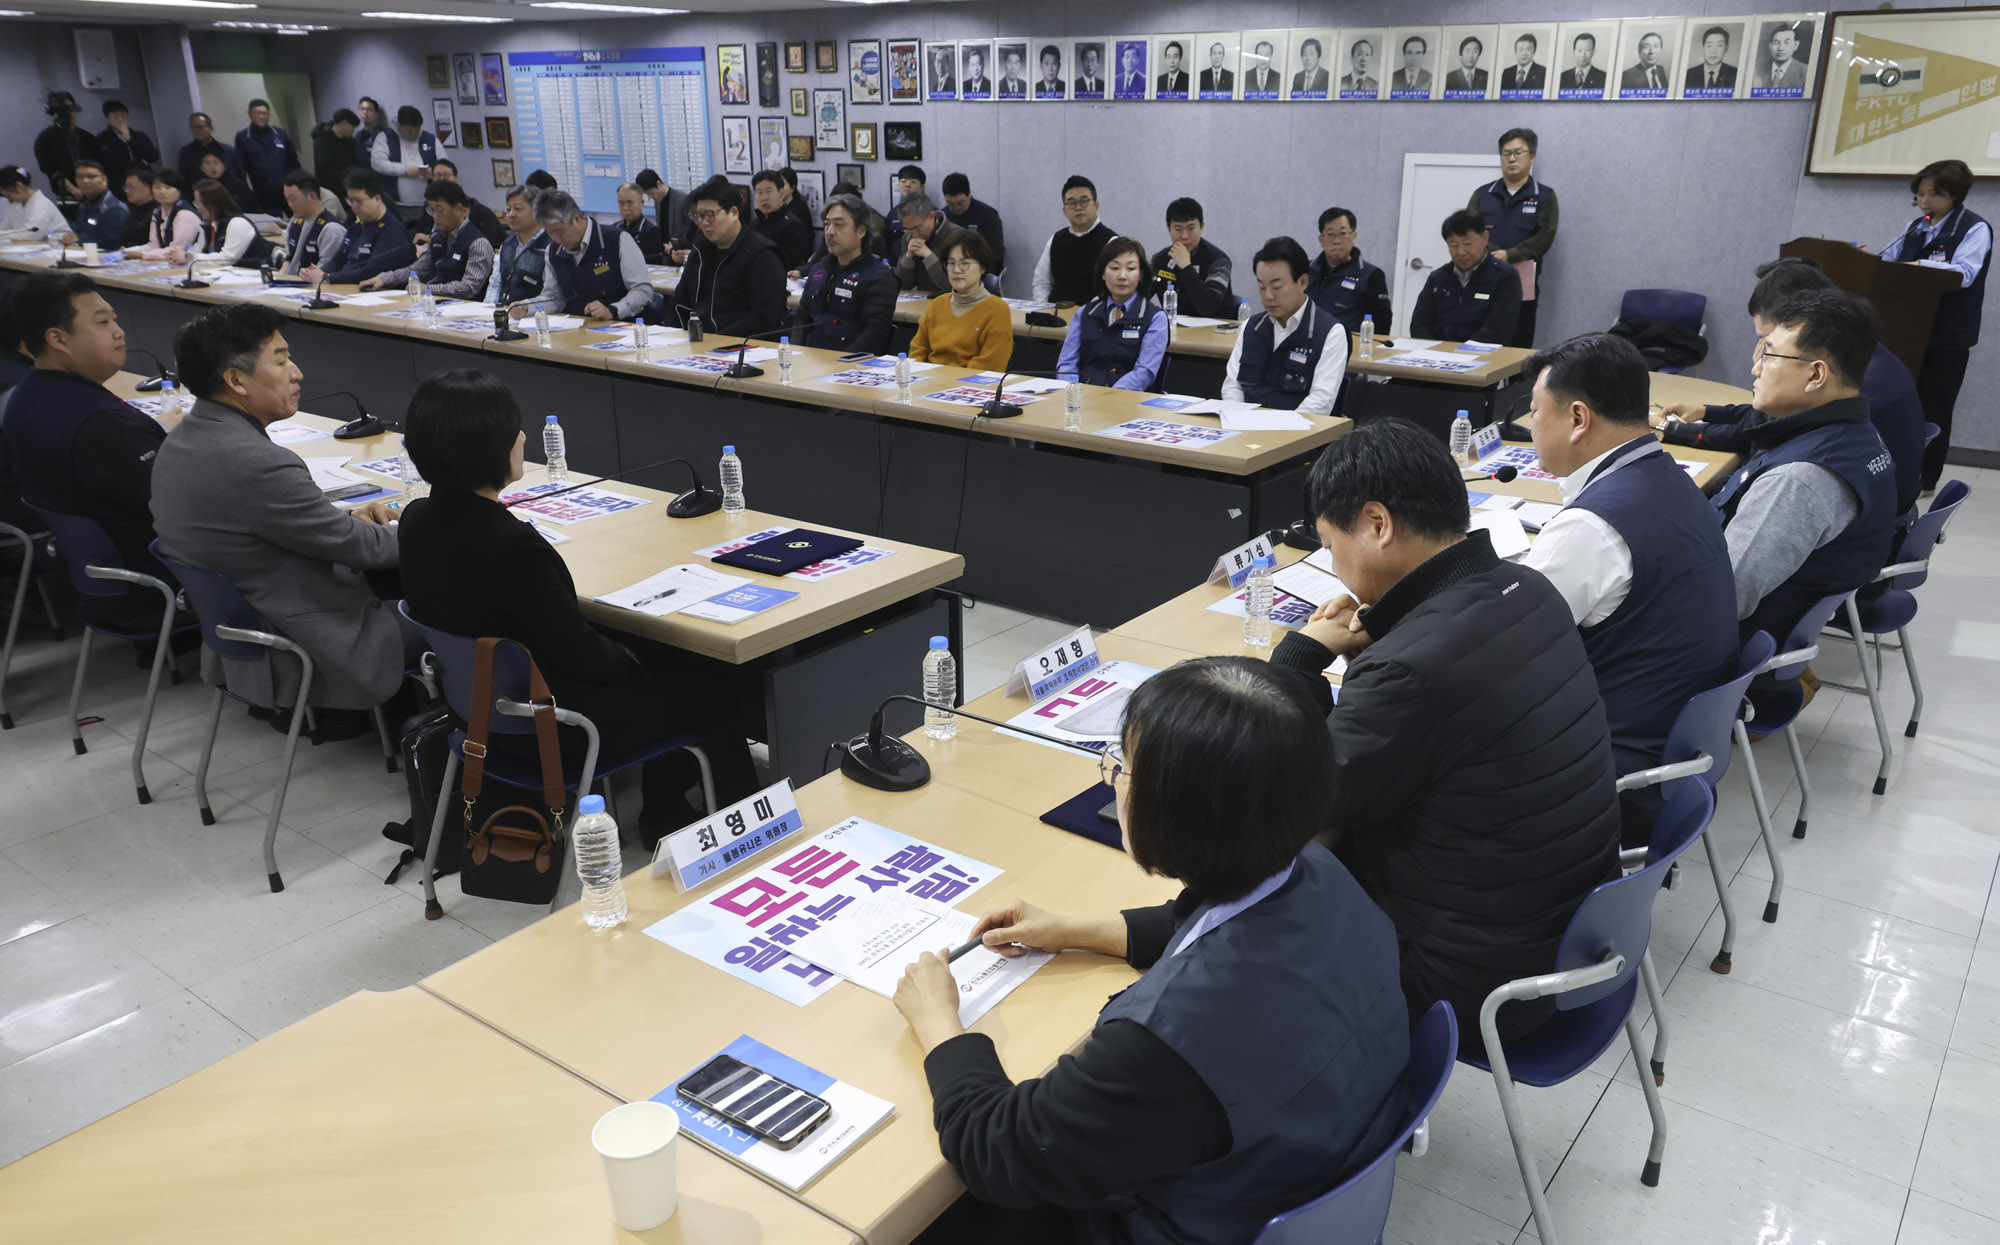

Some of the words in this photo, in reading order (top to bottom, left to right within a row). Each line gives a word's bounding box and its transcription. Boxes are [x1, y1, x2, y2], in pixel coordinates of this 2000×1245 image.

[1848, 104, 1917, 144] 대한노총
[1960, 75, 1997, 104] 연맹
[1855, 95, 1912, 111] FKTU
[1039, 638, 1084, 677] 오재형
[696, 795, 775, 853] 최영미
[764, 821, 788, 844] 위원장
[832, 820, 859, 837] 한국노총
[710, 845, 860, 929] 모든
[905, 864, 980, 904] 립!
[723, 894, 856, 974] 일하는
[855, 844, 946, 894] 사람
